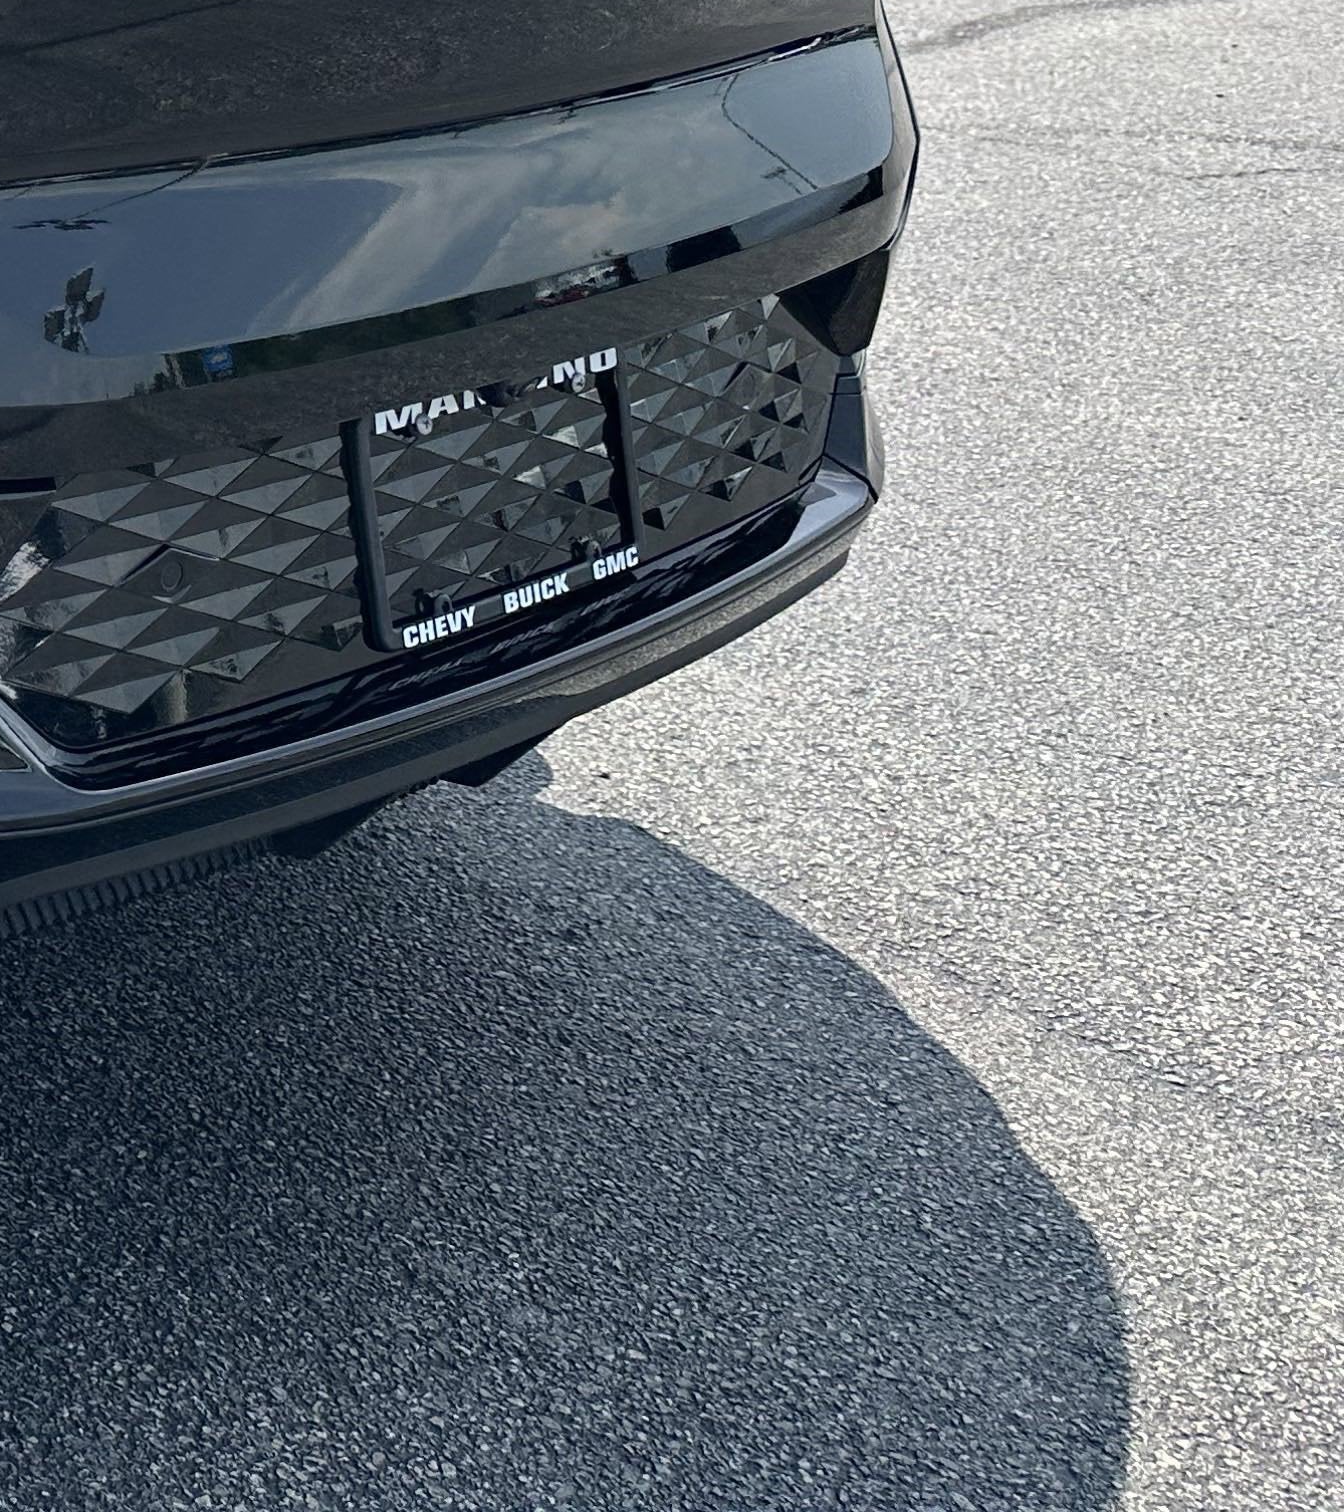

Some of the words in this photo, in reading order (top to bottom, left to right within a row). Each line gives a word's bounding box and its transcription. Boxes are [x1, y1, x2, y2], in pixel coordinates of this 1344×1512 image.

[374, 347, 618, 435] MANO
[403, 606, 476, 649] CHEVY
[503, 572, 570, 614] BUICK
[592, 546, 640, 581] GMC
